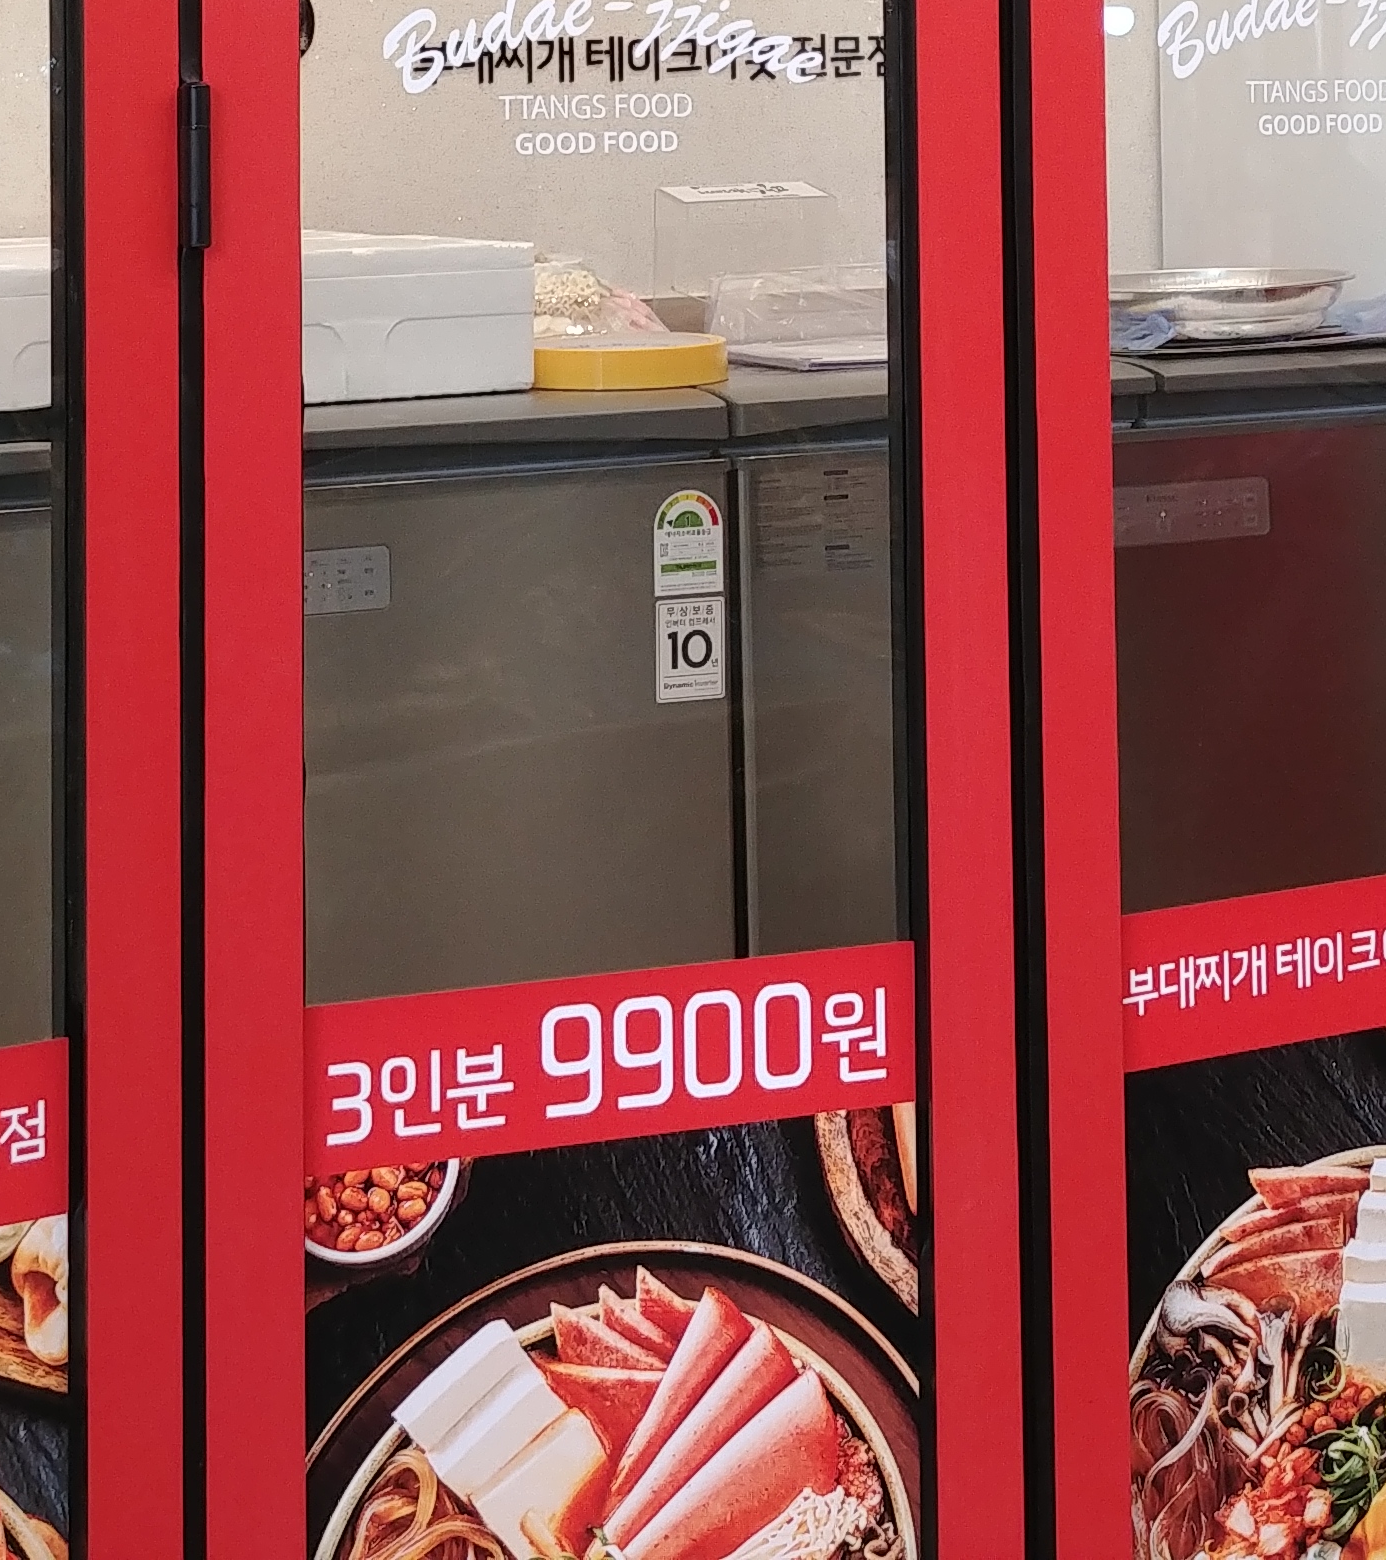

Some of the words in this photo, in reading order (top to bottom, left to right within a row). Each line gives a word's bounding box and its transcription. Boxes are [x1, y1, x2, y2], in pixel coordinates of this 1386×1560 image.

[1245, 80, 1330, 104] TTANGS
[497, 93, 607, 122] TTANGS
[614, 92, 694, 120] FOOD
[1258, 115, 1321, 136] GOOD
[1326, 113, 1383, 135] FOOD
[514, 131, 596, 156] GOOD
[602, 129, 679, 155] FOOD
[1121, 943, 1267, 1017] 부대찌개
[325, 1043, 515, 1147] 3인분
[540, 981, 888, 1120] 9900원
